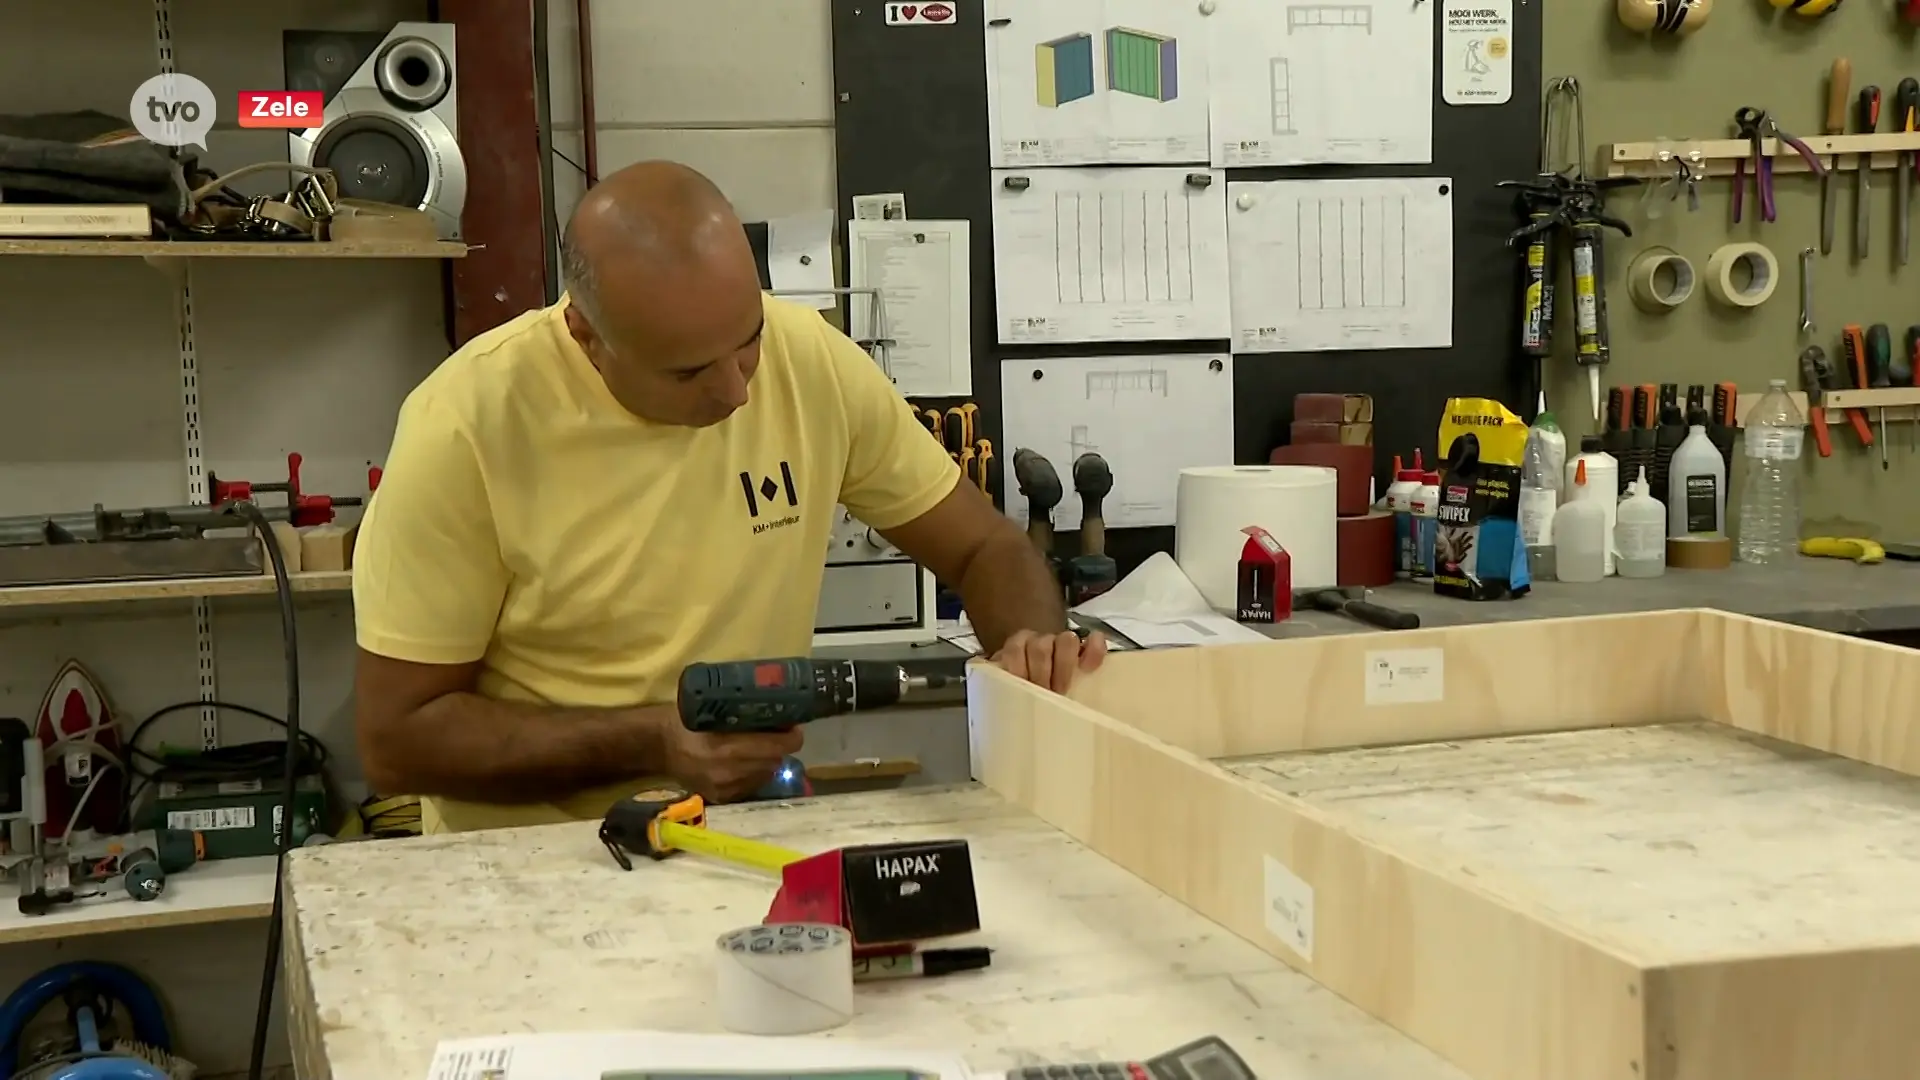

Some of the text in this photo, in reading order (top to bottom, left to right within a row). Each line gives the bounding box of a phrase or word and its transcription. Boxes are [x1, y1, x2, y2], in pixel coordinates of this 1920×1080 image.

[890, 5, 899, 22] I
[1448, 9, 1471, 18] MOOI
[1482, 415, 1504, 427] PACK
[1439, 504, 1471, 523] SWIPEX
[1241, 609, 1271, 620] HAPAX
[875, 853, 940, 880] HAPAX
